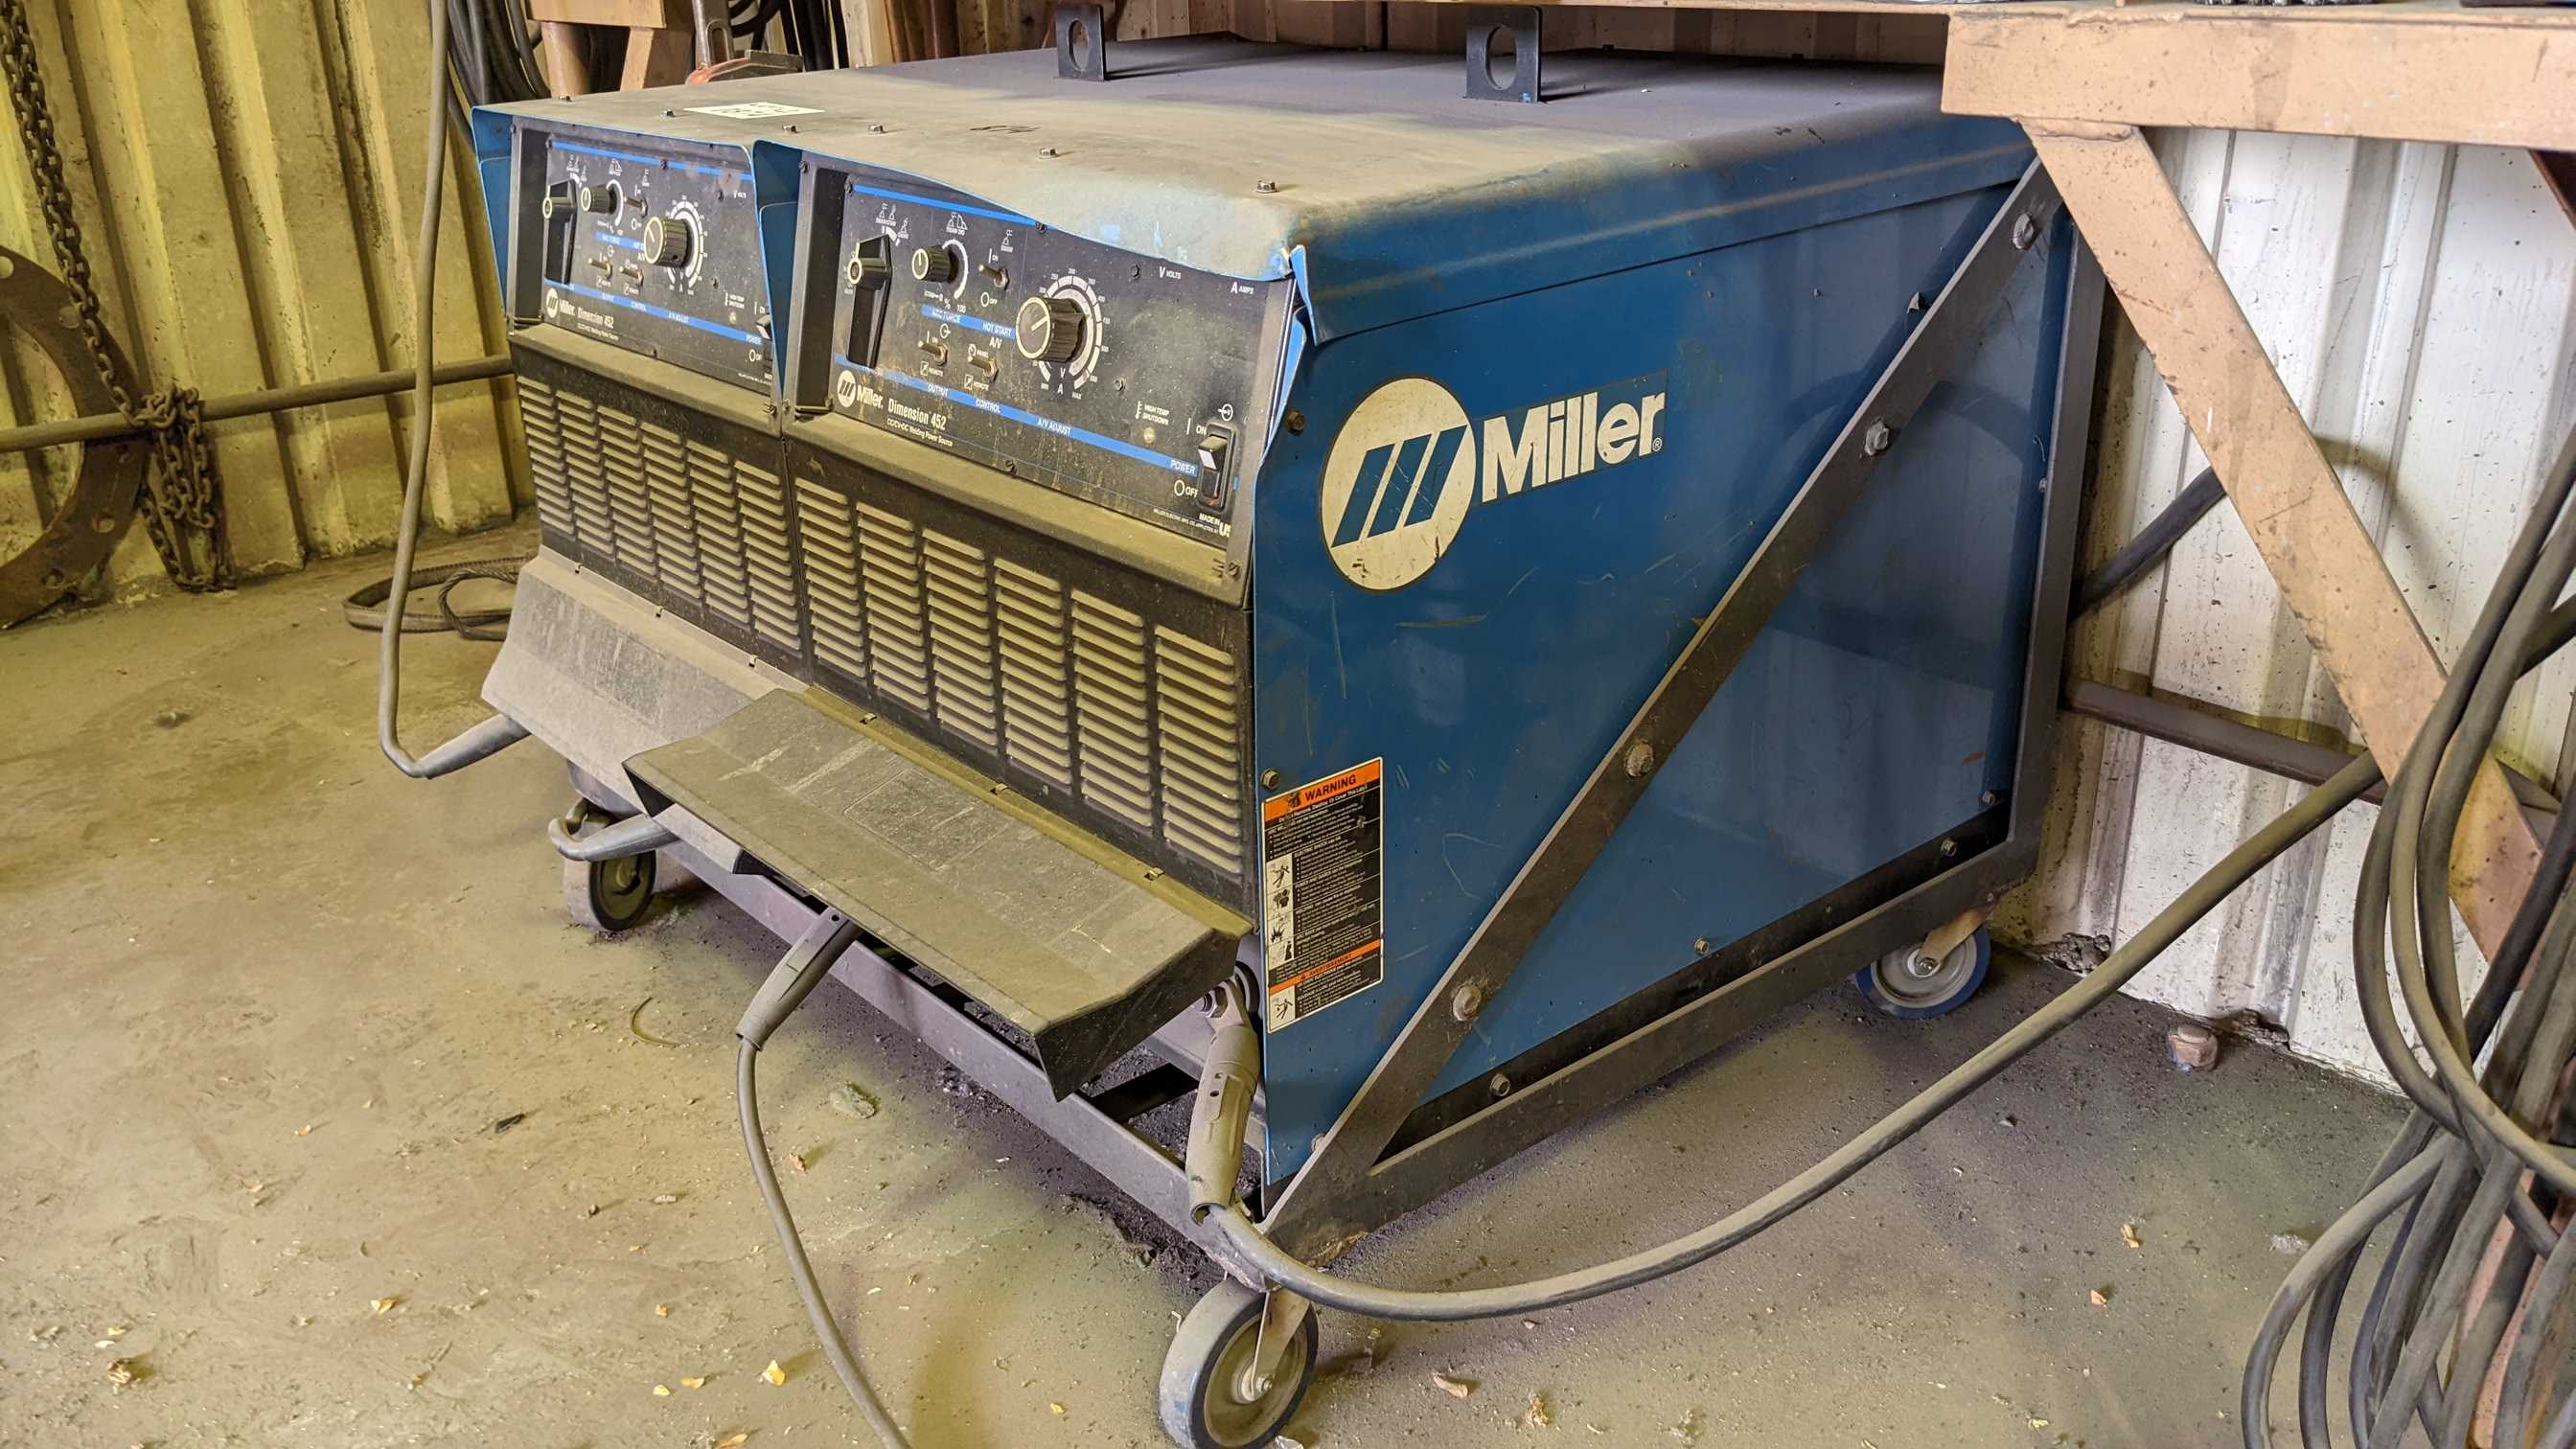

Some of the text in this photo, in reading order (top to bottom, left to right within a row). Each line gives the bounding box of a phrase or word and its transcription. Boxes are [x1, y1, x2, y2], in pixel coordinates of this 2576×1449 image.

[604, 315, 614, 330] 452
[996, 326, 1012, 337] START
[1060, 368, 1066, 379] V
[928, 384, 949, 397] OUTPUT
[1057, 383, 1064, 395] A
[976, 399, 1000, 414] CONTROL
[887, 398, 948, 431] Dimension 452
[1048, 421, 1071, 437] ADJUST
[1196, 425, 1207, 436] ON
[1170, 459, 1196, 474] POWER
[1185, 487, 1198, 497] OFF
[1304, 774, 1357, 801] WARNING
